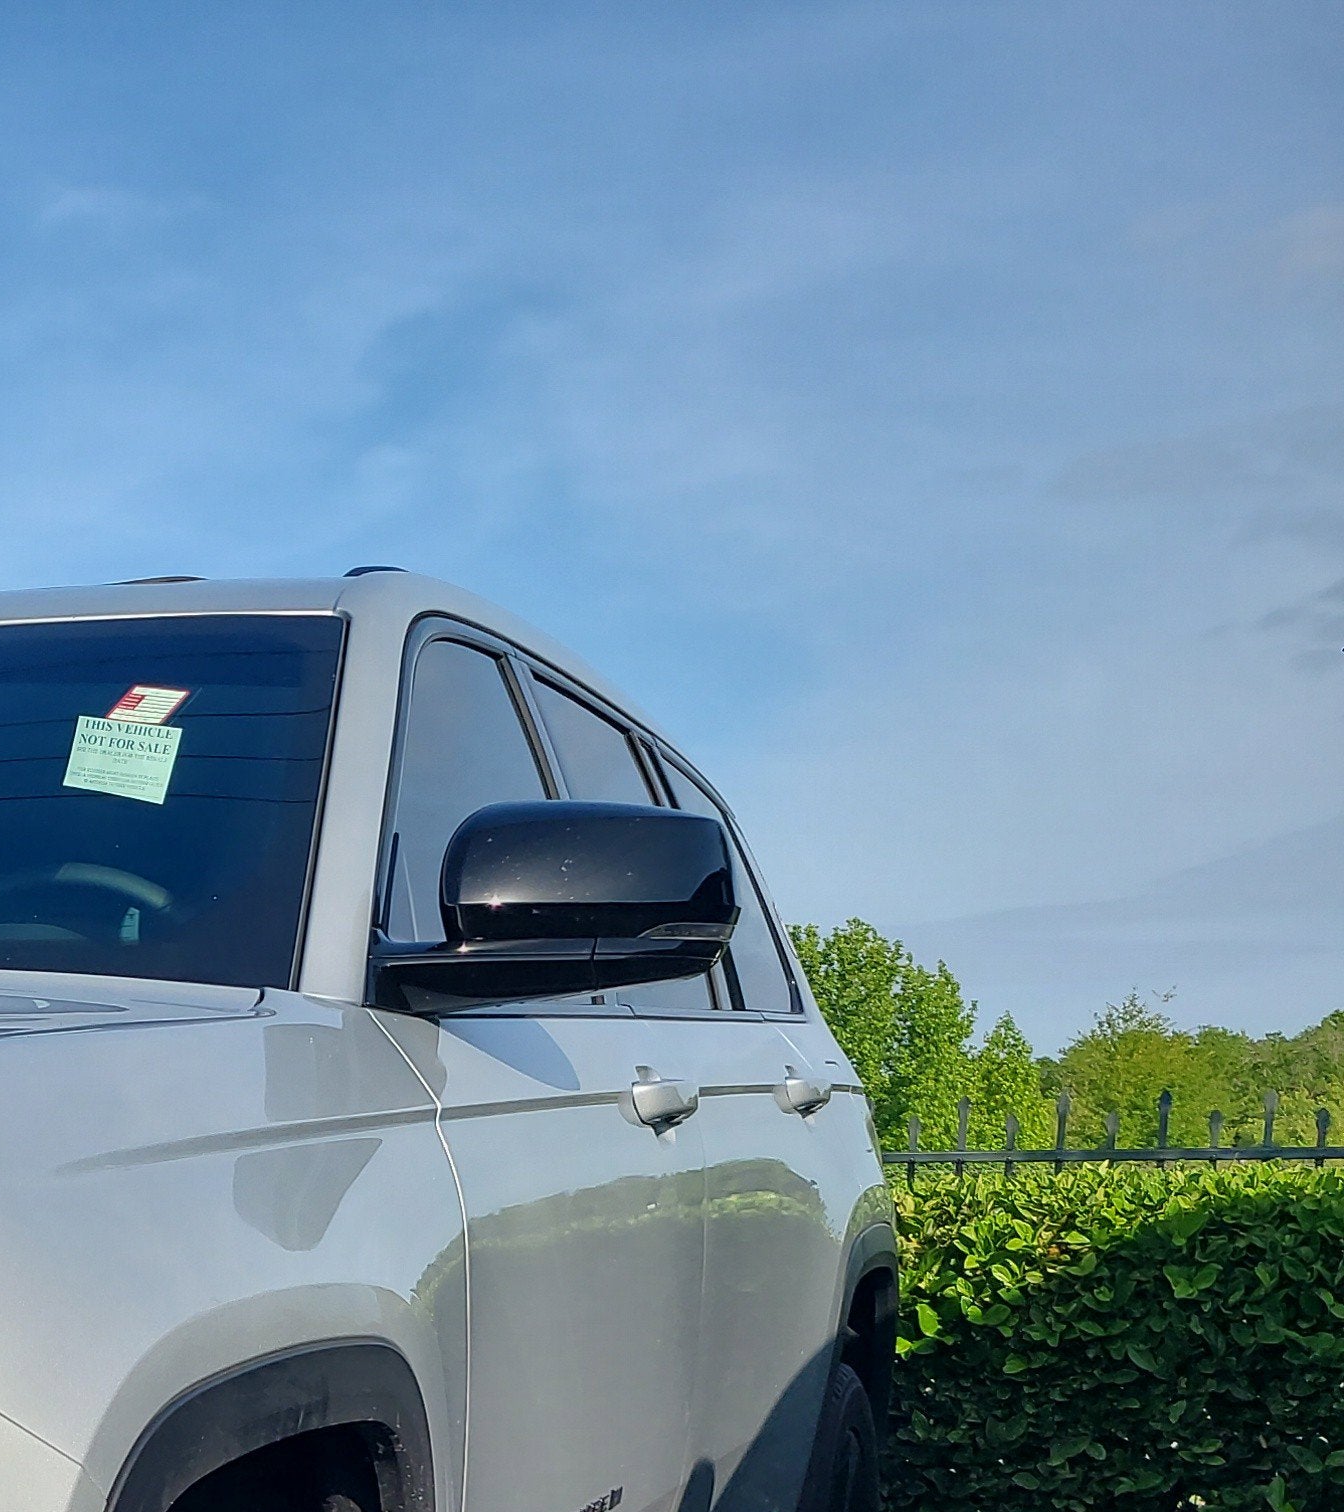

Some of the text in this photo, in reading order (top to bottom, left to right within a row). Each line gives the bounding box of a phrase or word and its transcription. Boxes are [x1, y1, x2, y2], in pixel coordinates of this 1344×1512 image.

[85, 719, 173, 740] THIS VEHICLE
[78, 733, 172, 755] NOT FOR SALE
